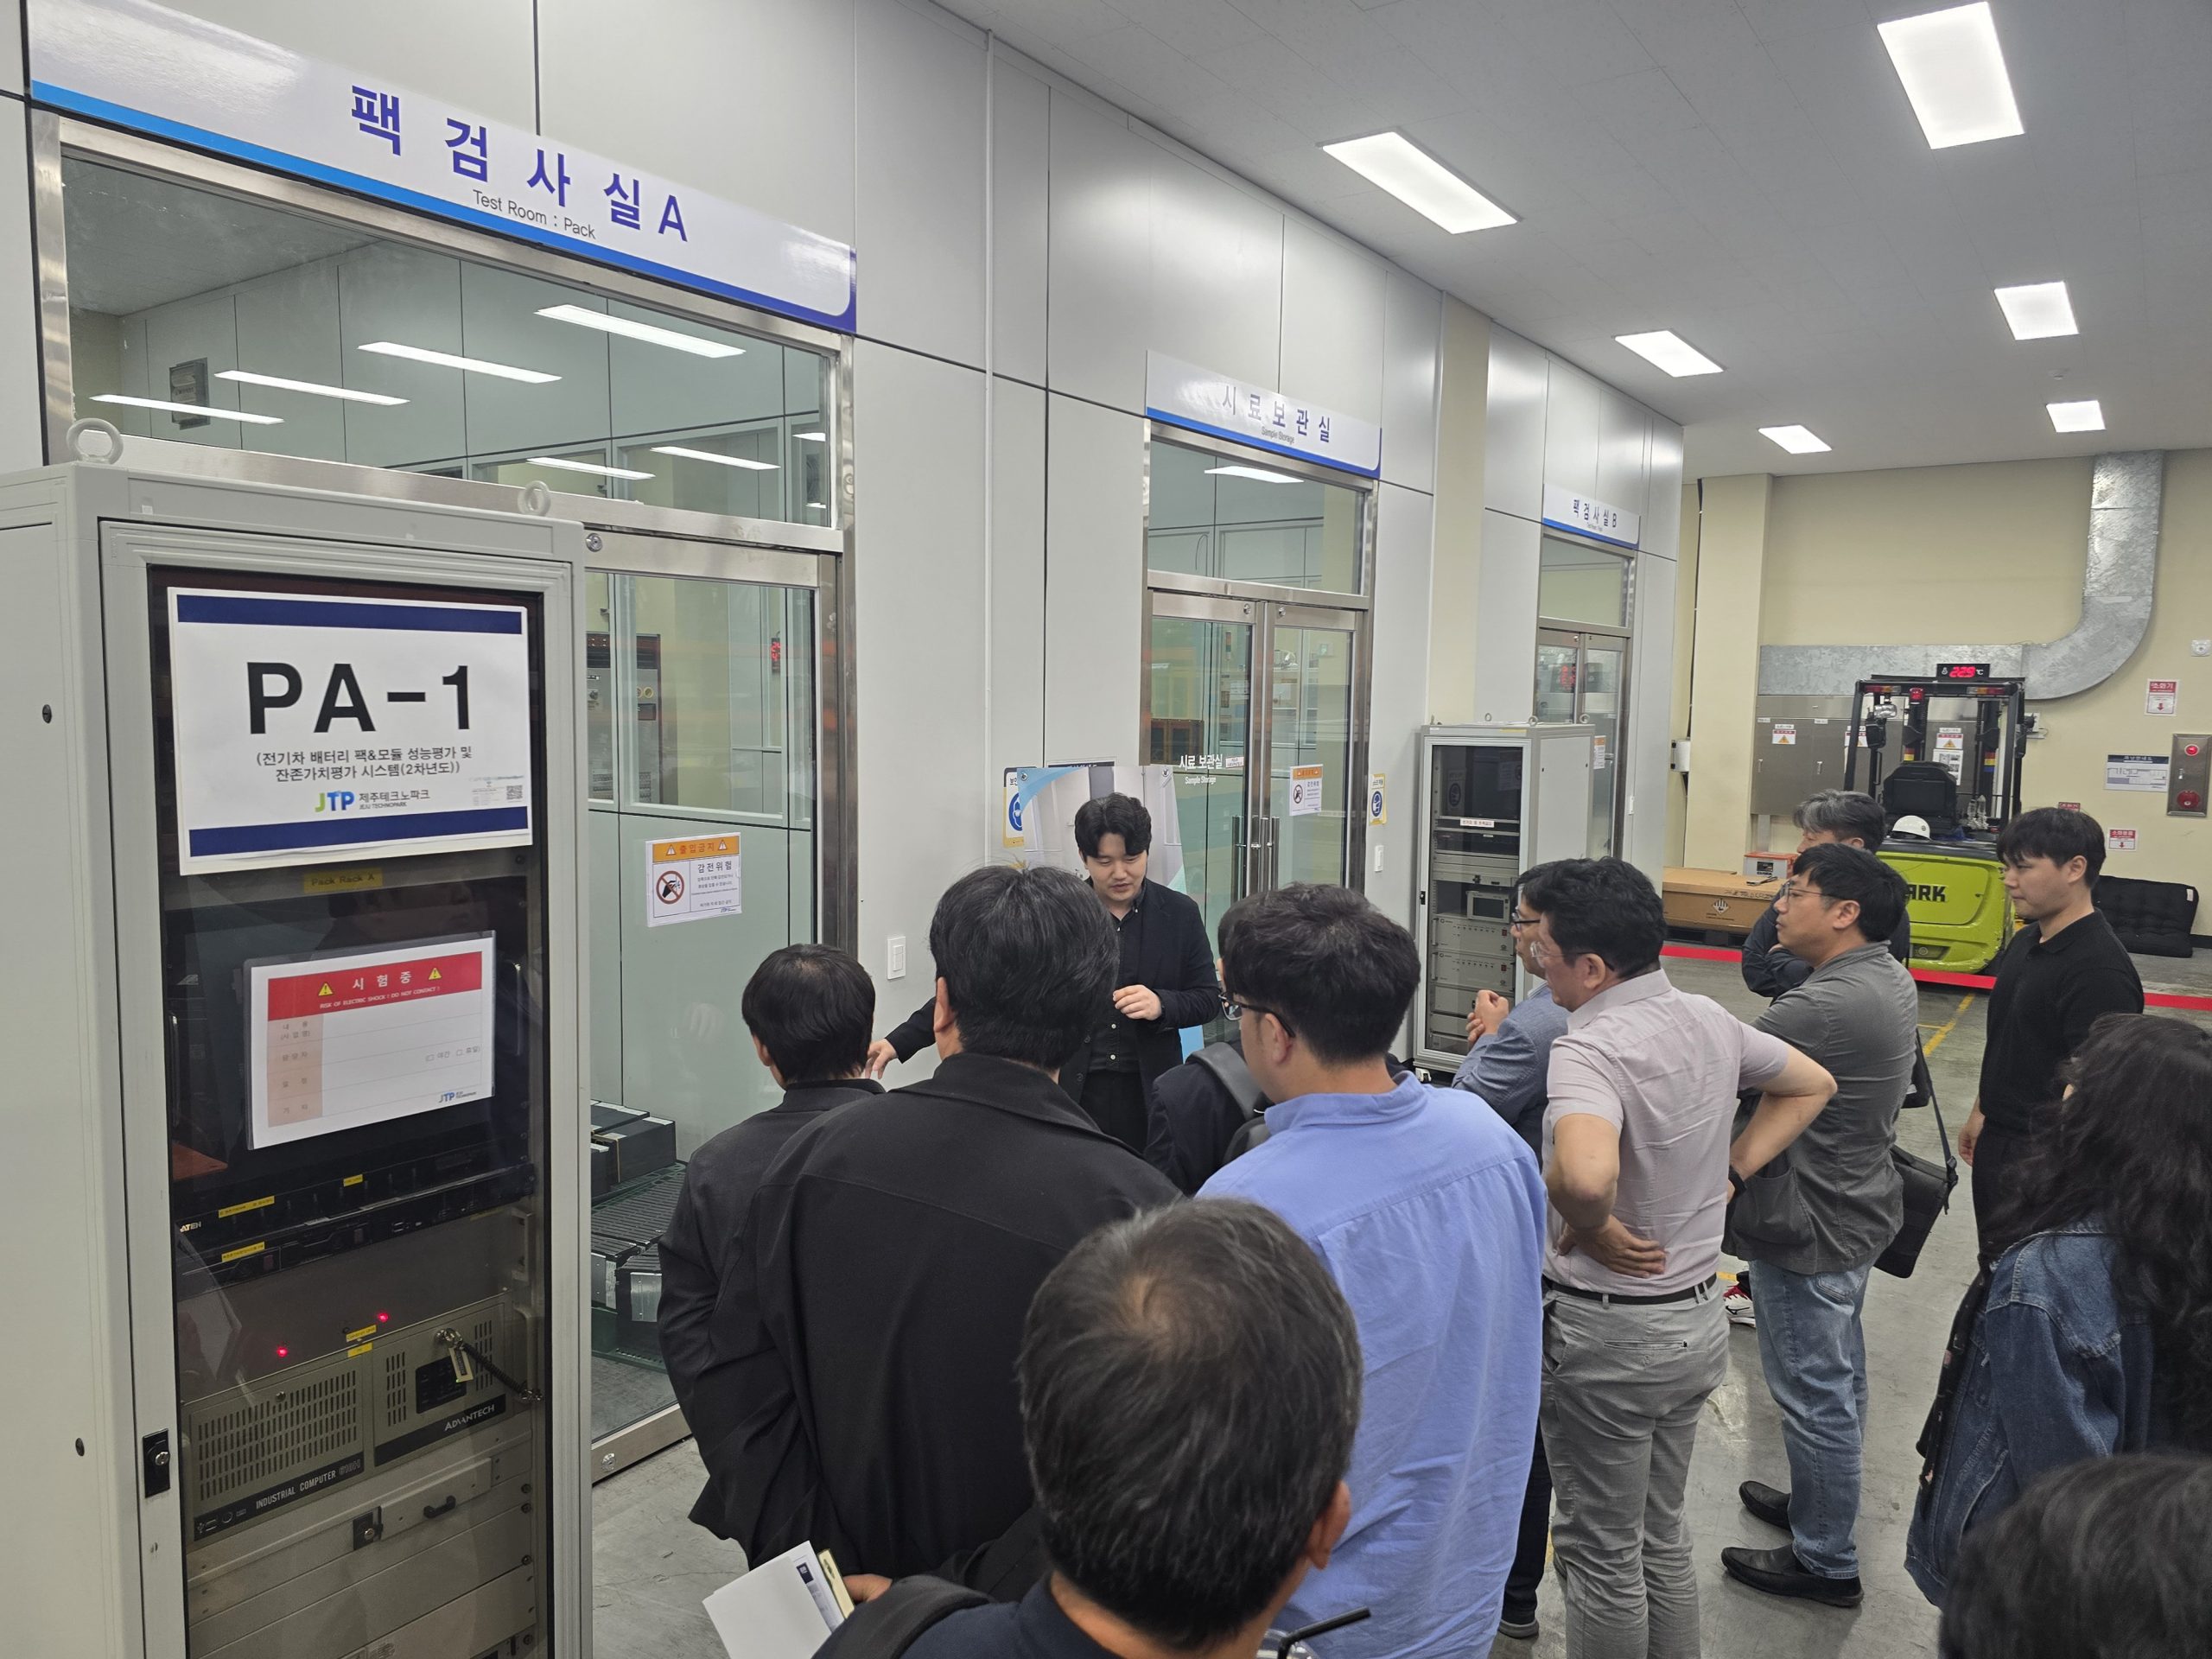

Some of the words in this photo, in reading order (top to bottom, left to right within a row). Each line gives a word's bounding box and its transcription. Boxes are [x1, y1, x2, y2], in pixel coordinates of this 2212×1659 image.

[473, 189, 502, 213] Test
[508, 200, 548, 226] Room
[563, 217, 596, 239] Pack
[1262, 426, 1278, 440] Sample
[1278, 430, 1295, 444] Storage
[247, 662, 470, 734] PA-1
[256, 750, 305, 767] (전기차
[310, 749, 350, 765] 배터리
[354, 747, 403, 763] 팩&모듈
[407, 747, 455, 761] 성능평가
[461, 746, 473, 759] 및
[1196, 753, 1224, 770] 보관실
[276, 765, 357, 782] 잔존가치평가
[361, 762, 461, 779] 시스템(2차년도))
[315, 791, 355, 813] JTP
[359, 790, 430, 804] 제주테크노파크
[679, 842, 715, 855] 출입금지
[697, 861, 732, 874] 감전위험
[439, 1091, 455, 1103] JTP
[180, 1221, 202, 1233] ATEN
[443, 1404, 495, 1432] ADVANTECH
[256, 1486, 296, 1510] INDUSTRIAL
[299, 1470, 336, 1492] COMPUTER
